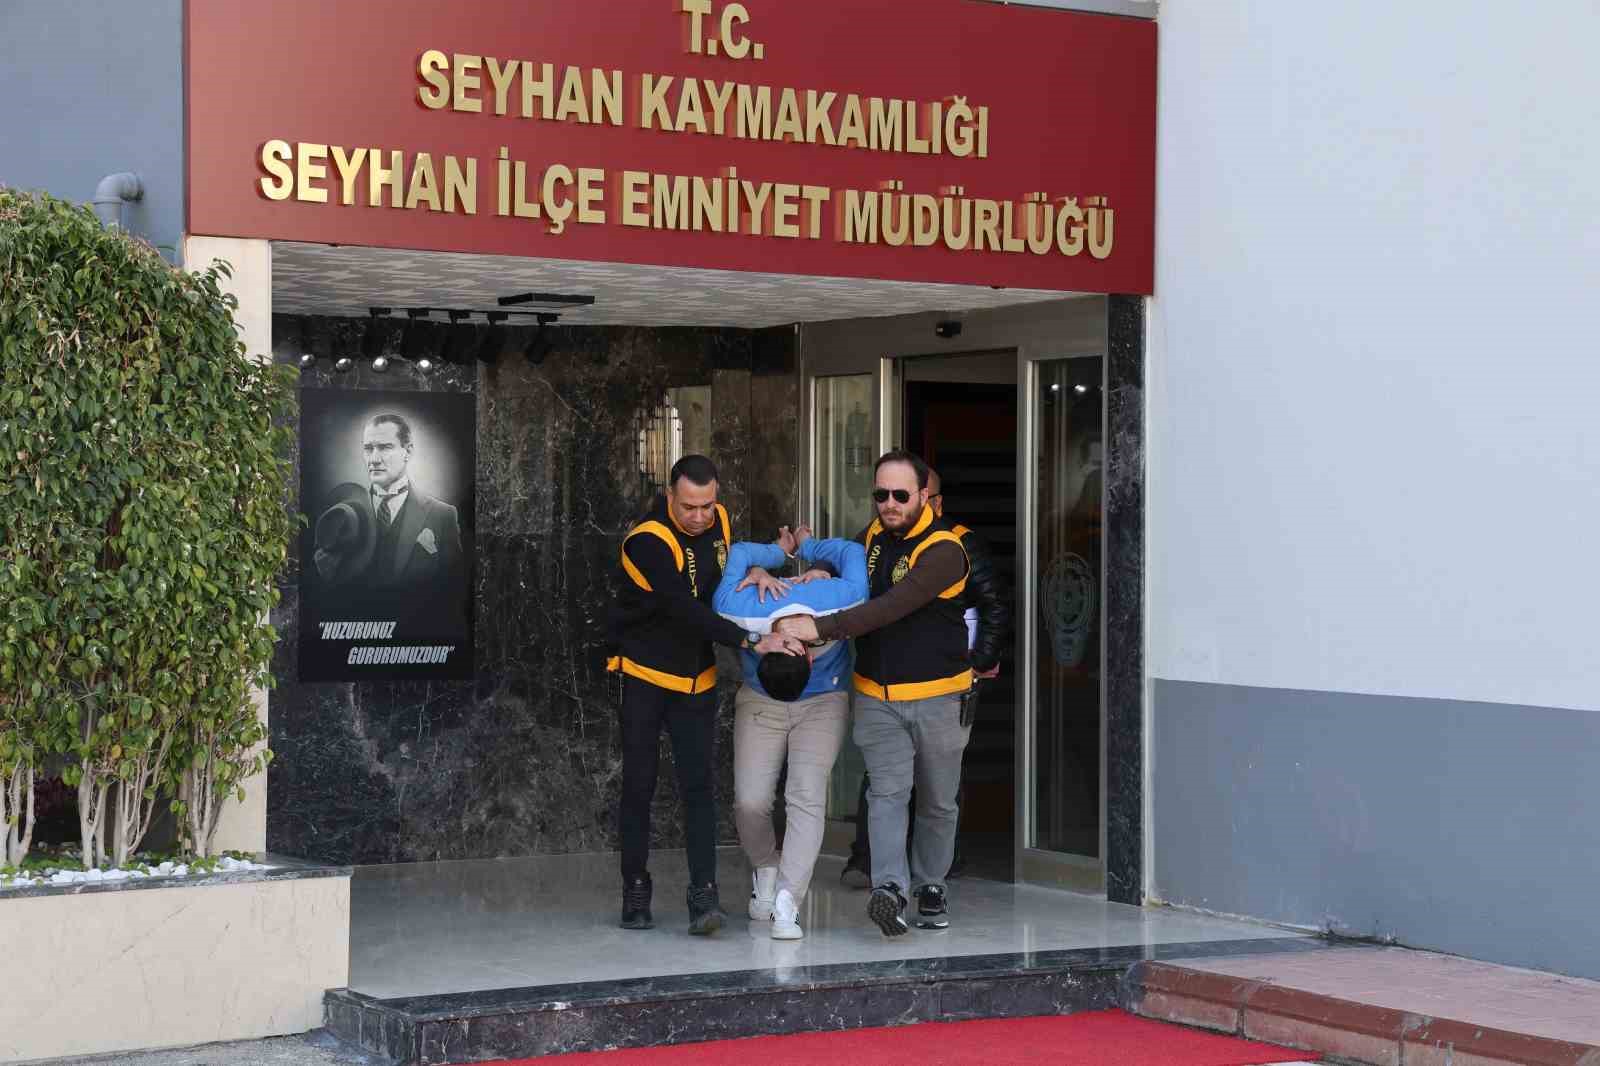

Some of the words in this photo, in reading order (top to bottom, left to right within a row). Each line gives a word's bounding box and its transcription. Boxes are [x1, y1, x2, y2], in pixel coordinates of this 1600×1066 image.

[682, 0, 765, 60] T.C.
[417, 49, 624, 126] SEYHAN
[640, 73, 989, 159] KAYMAKAMLIĞI
[259, 139, 478, 215] SEYHAN
[497, 146, 606, 235] İLÇE
[621, 166, 831, 239] EMNİYET
[844, 179, 1115, 260] MÜDÜRLÜĞÜ
